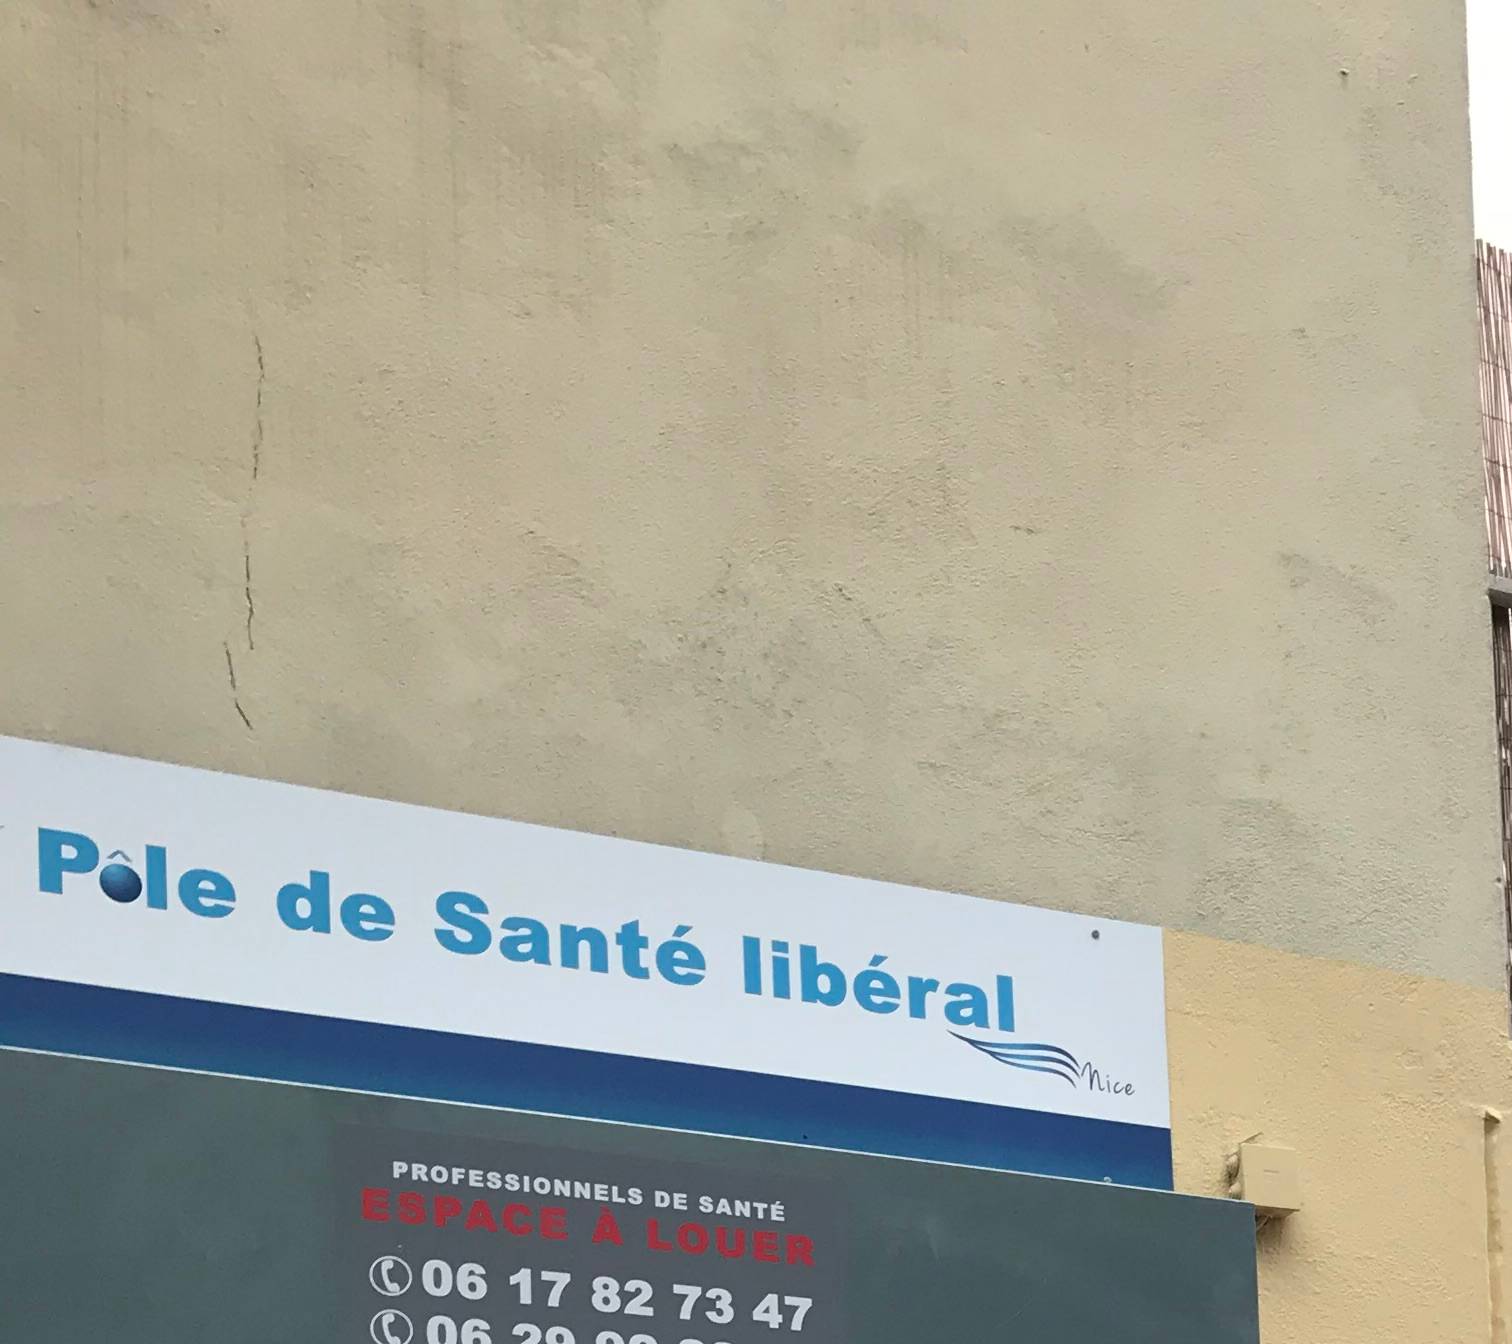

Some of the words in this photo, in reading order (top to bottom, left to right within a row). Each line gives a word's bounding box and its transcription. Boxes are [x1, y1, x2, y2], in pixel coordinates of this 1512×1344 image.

[37, 827, 237, 919] Pôle
[276, 869, 396, 942] de
[434, 890, 707, 986] Santé
[741, 935, 1015, 1032] libéral
[1081, 1061, 1136, 1096] Nice
[361, 1187, 568, 1241] ESPACE
[591, 1206, 624, 1246] À
[646, 1218, 815, 1267] LOUER
[392, 1161, 643, 1205] PROFESSIONNELS
[654, 1190, 688, 1210] DE
[698, 1196, 785, 1221] SANTÉ
[422, 1259, 488, 1300] 06
[509, 1267, 571, 1308] 17
[591, 1276, 654, 1317] 82
[672, 1283, 735, 1324] 73
[752, 1293, 813, 1332] 47
